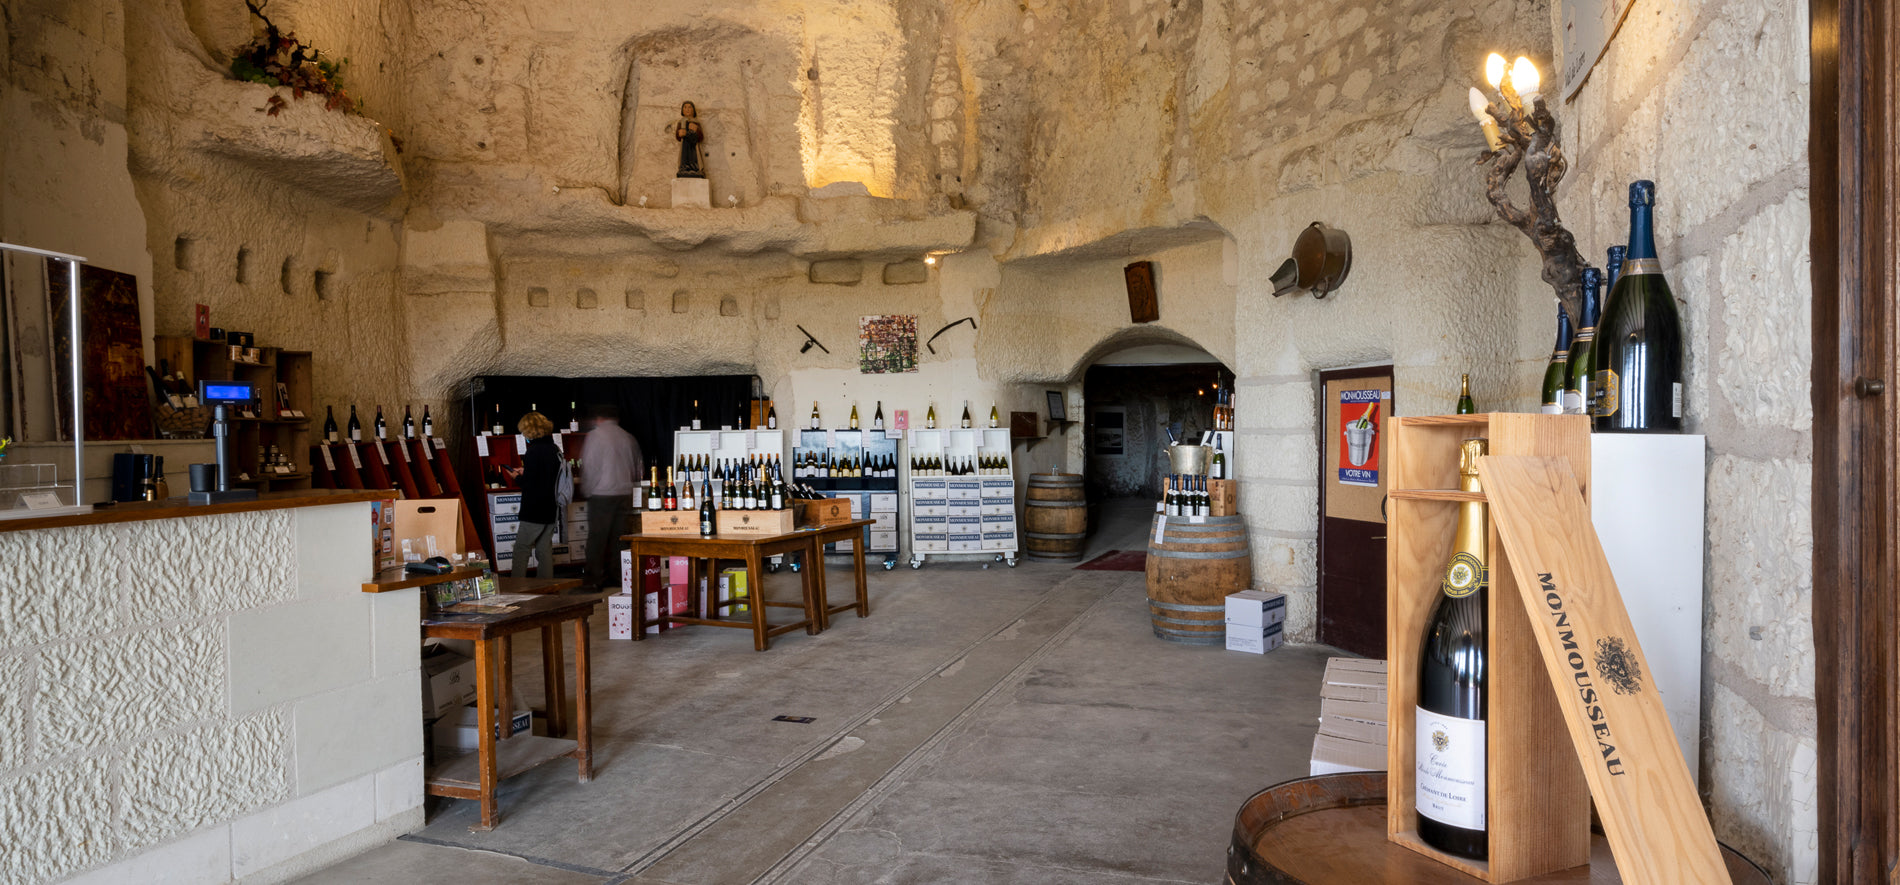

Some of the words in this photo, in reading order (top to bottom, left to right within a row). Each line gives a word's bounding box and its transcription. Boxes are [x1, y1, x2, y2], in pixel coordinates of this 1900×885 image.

[1341, 390, 1380, 400] MONMOUSSEAU
[1345, 469, 1361, 477] VOTRE
[1537, 572, 1625, 777] MONMOUSSEAU
